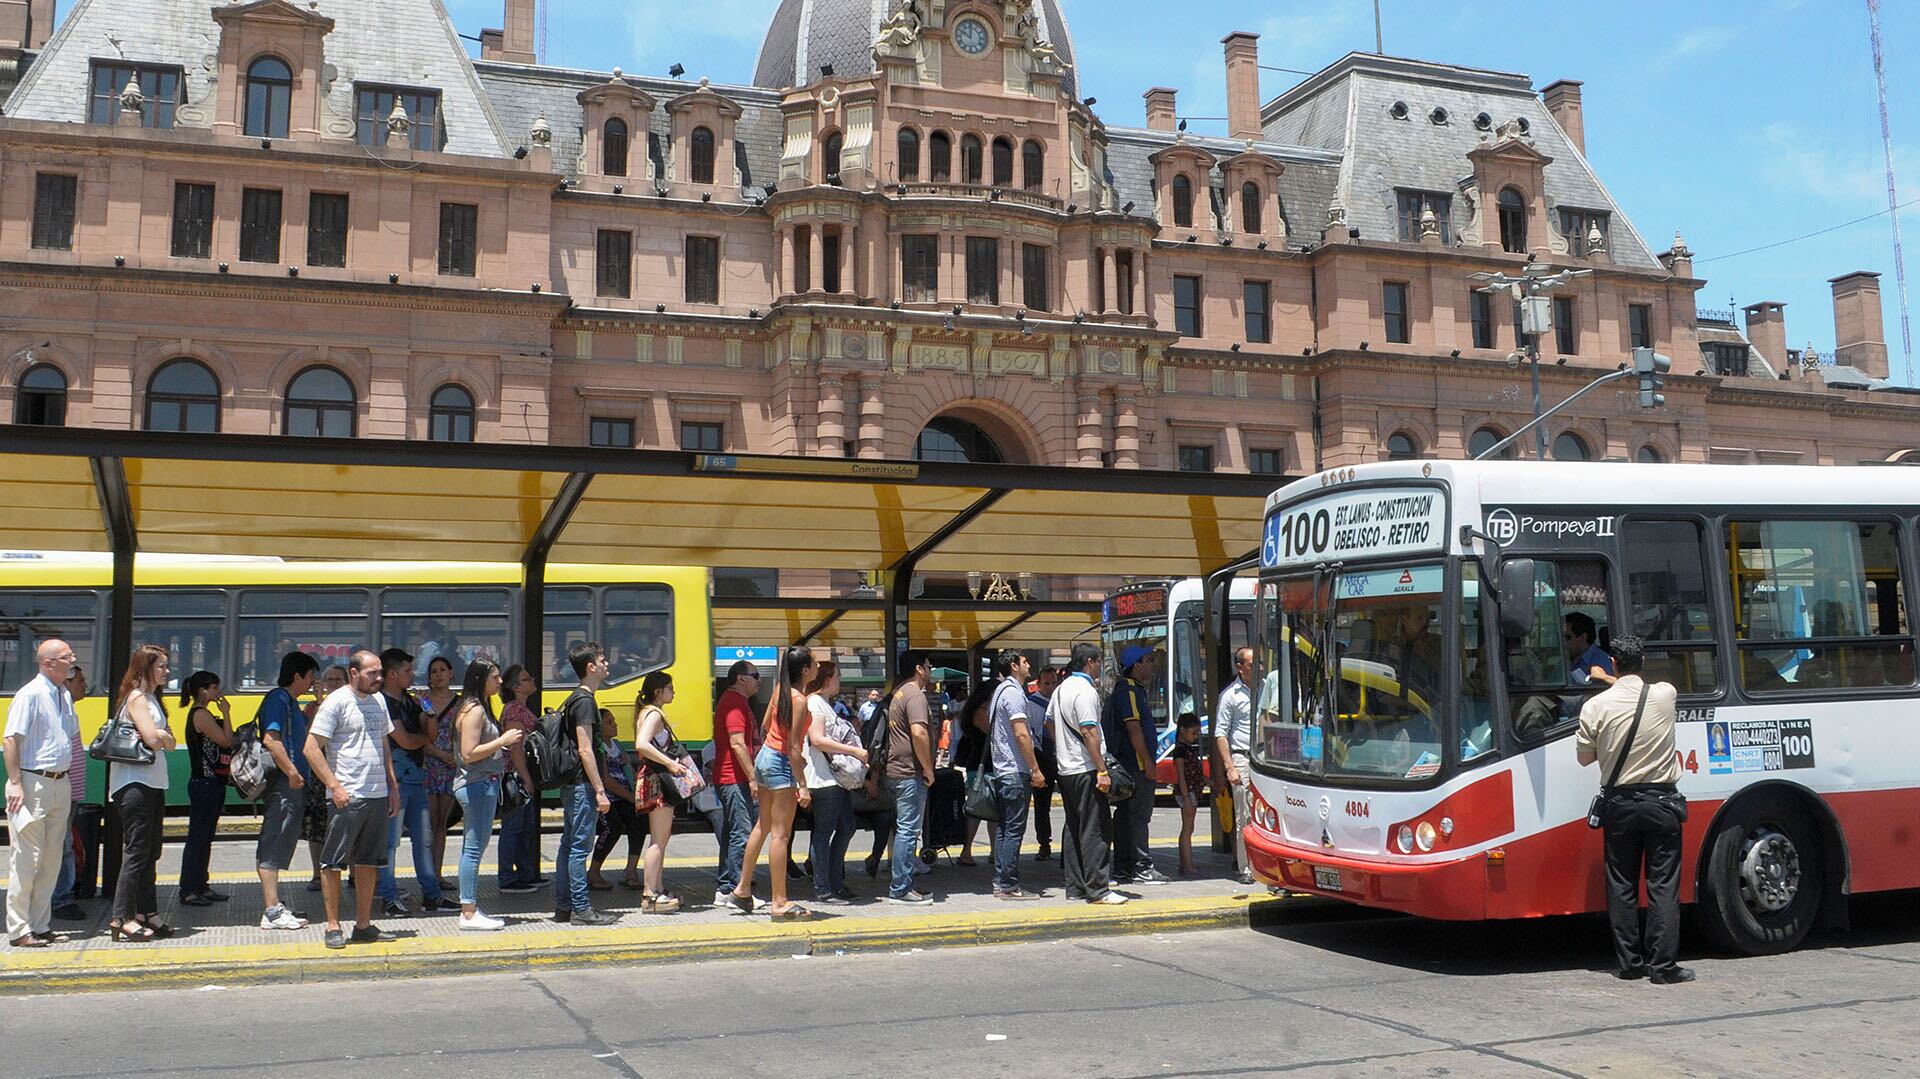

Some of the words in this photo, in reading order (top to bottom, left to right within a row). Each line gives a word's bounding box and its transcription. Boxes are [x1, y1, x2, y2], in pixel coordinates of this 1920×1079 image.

[712, 457, 726, 467] 65
[852, 464, 913, 476] Constitución
[1335, 504, 1349, 527] EST.
[1349, 502, 1372, 525] LANUS
[1375, 495, 1434, 521] CONSTITUCION
[1281, 508, 1331, 558] 100
[1334, 526, 1381, 551] OBELISCO
[1388, 521, 1430, 546] RETIRO
[1490, 518, 1514, 538] TB
[1521, 516, 1596, 539] Pompeya
[1596, 516, 1615, 537] II
[1348, 585, 1364, 596] CAR
[1781, 721, 1810, 729] LINEA
[1783, 735, 1812, 757] 100
[1345, 801, 1370, 818] 4804
